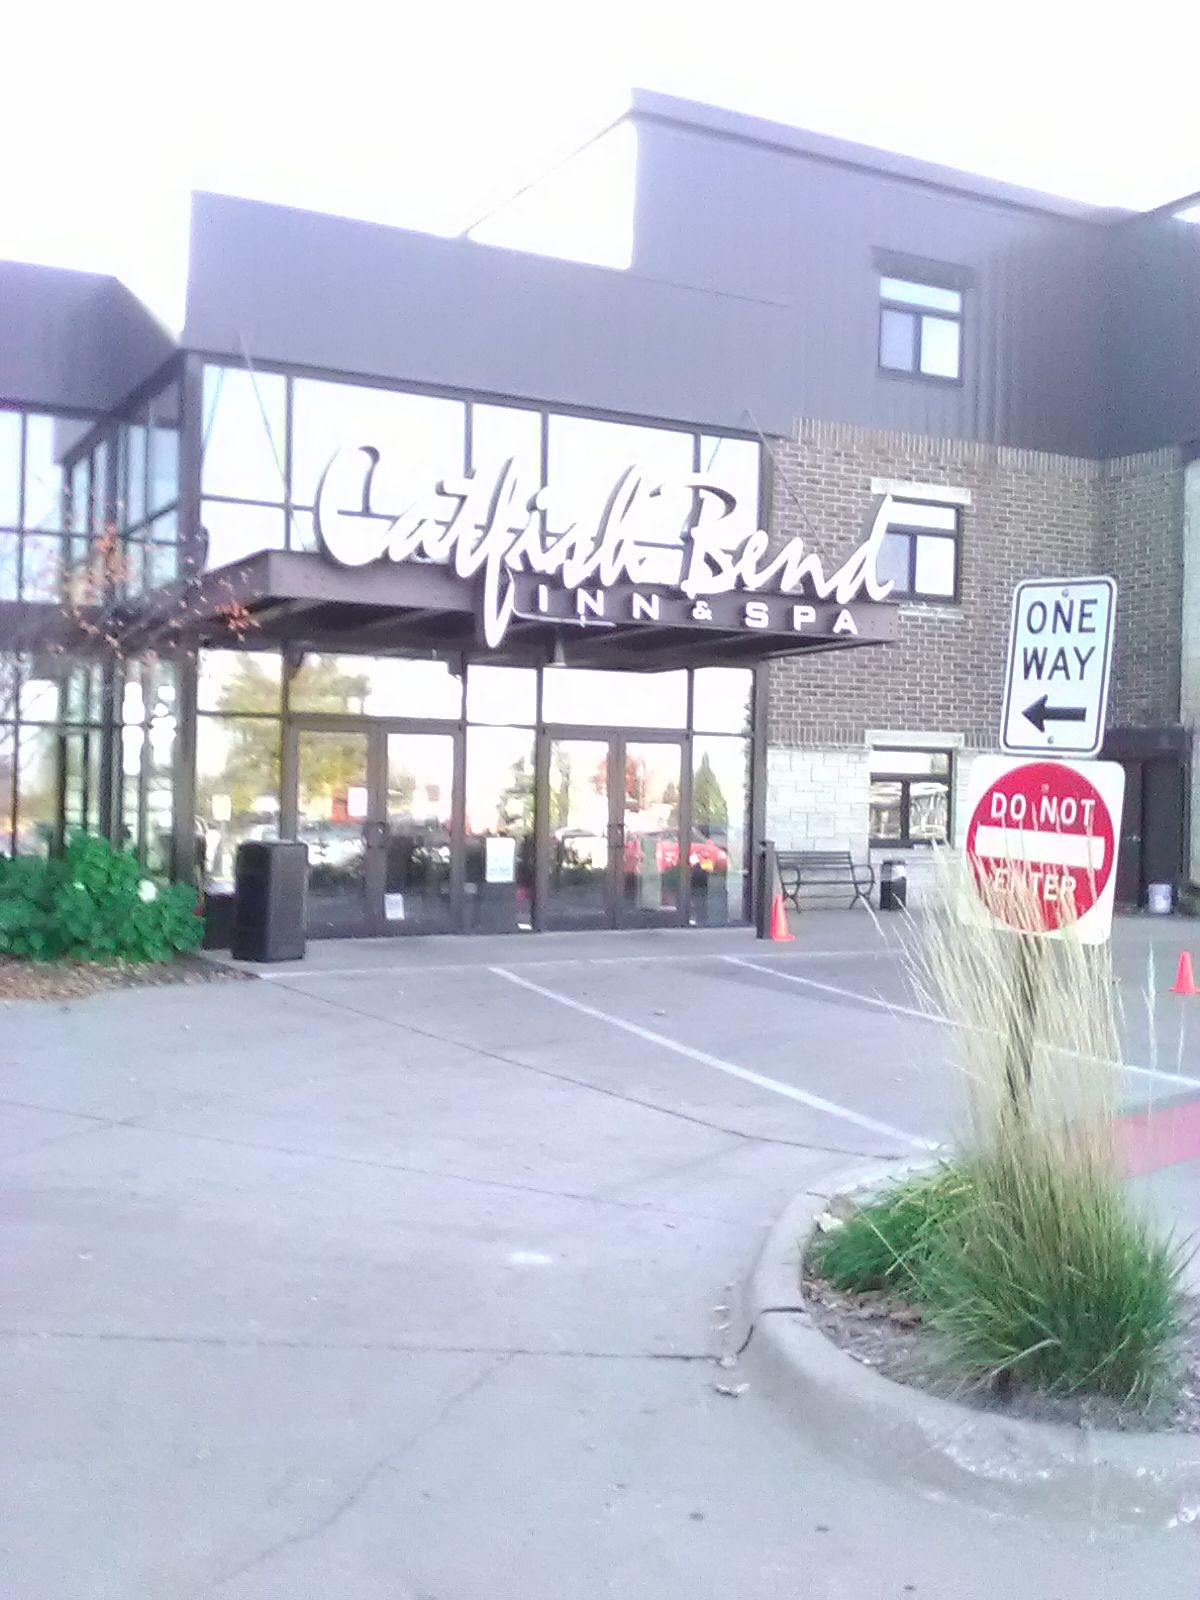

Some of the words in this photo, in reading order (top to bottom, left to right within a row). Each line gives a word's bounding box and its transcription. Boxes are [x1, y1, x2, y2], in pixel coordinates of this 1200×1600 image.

[314, 444, 662, 649] Catfish
[649, 472, 894, 604] Bend
[538, 584, 660, 621] INN
[692, 600, 713, 621] &
[745, 601, 859, 635] SPA
[1025, 598, 1099, 635] ONE
[1022, 646, 1097, 681] WAY
[990, 791, 1027, 821] DO
[1040, 795, 1096, 827] NOT
